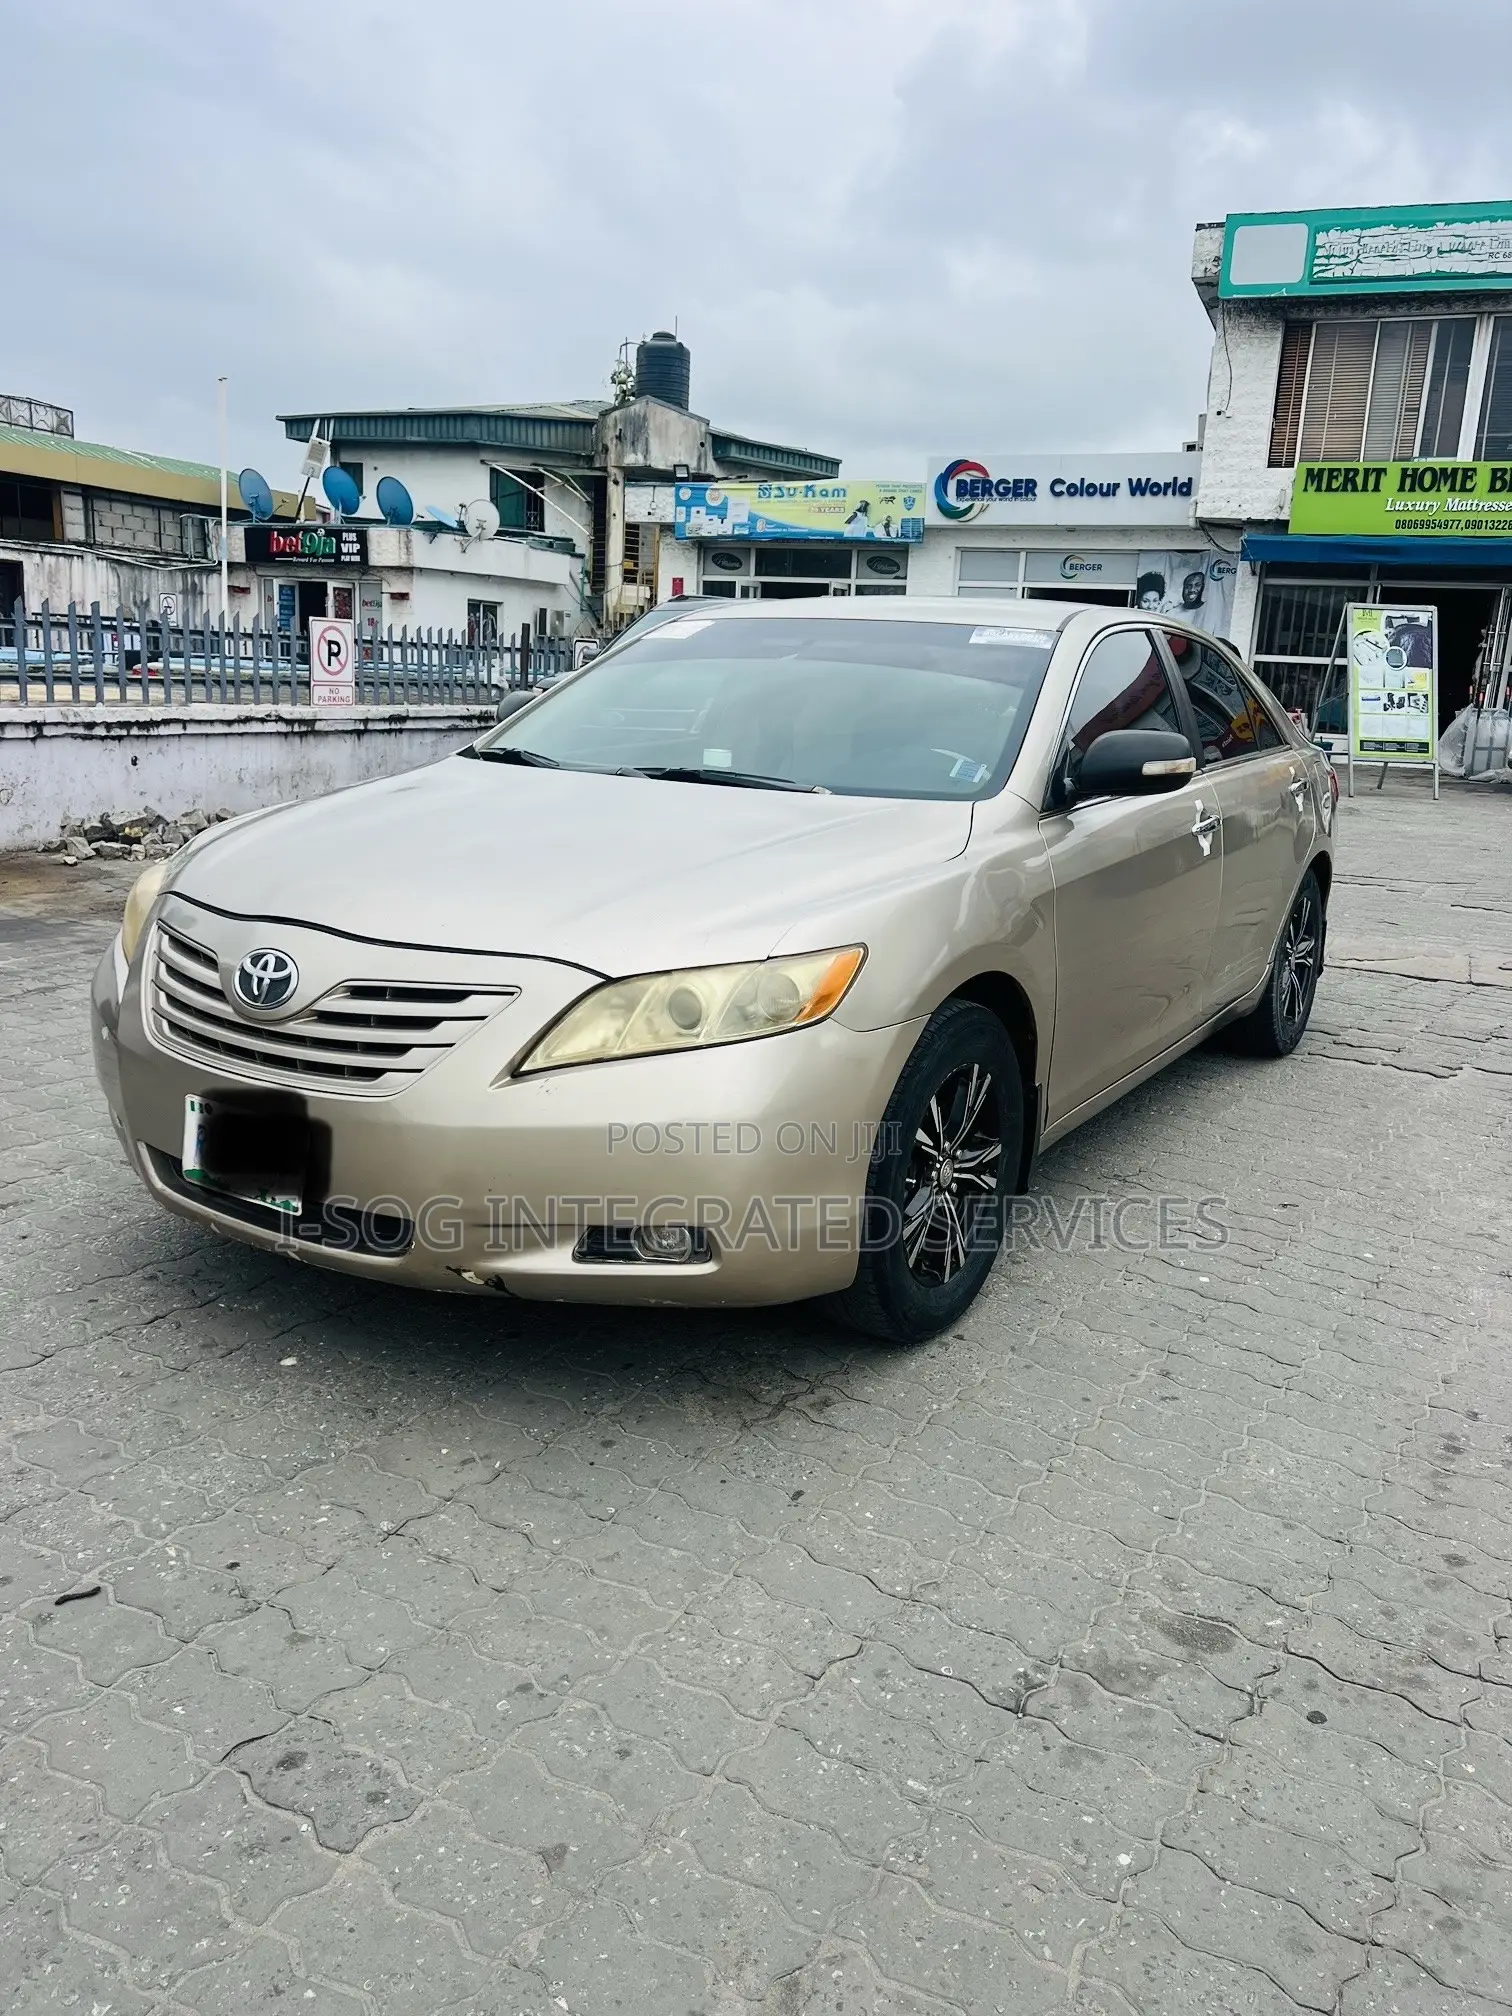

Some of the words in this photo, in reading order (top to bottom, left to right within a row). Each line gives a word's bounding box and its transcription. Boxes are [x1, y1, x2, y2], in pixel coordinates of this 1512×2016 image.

[1488, 251, 1501, 259] RC
[1302, 467, 1387, 493] MERIT
[1397, 466, 1478, 493] HOME
[955, 478, 1038, 498] BERGER
[1049, 477, 1121, 497] Colour
[1127, 476, 1193, 497] World
[1385, 498, 1441, 516] Luxury
[1443, 498, 1512, 513] Mattresse
[269, 528, 336, 556] bet9ja
[342, 532, 357, 542] PLUS
[340, 542, 360, 554] VIP
[1068, 563, 1103, 572] BERGER
[1217, 566, 1237, 575] BERG
[327, 639, 342, 667] P
[328, 687, 340, 695] NO
[317, 695, 351, 703] PARKING
